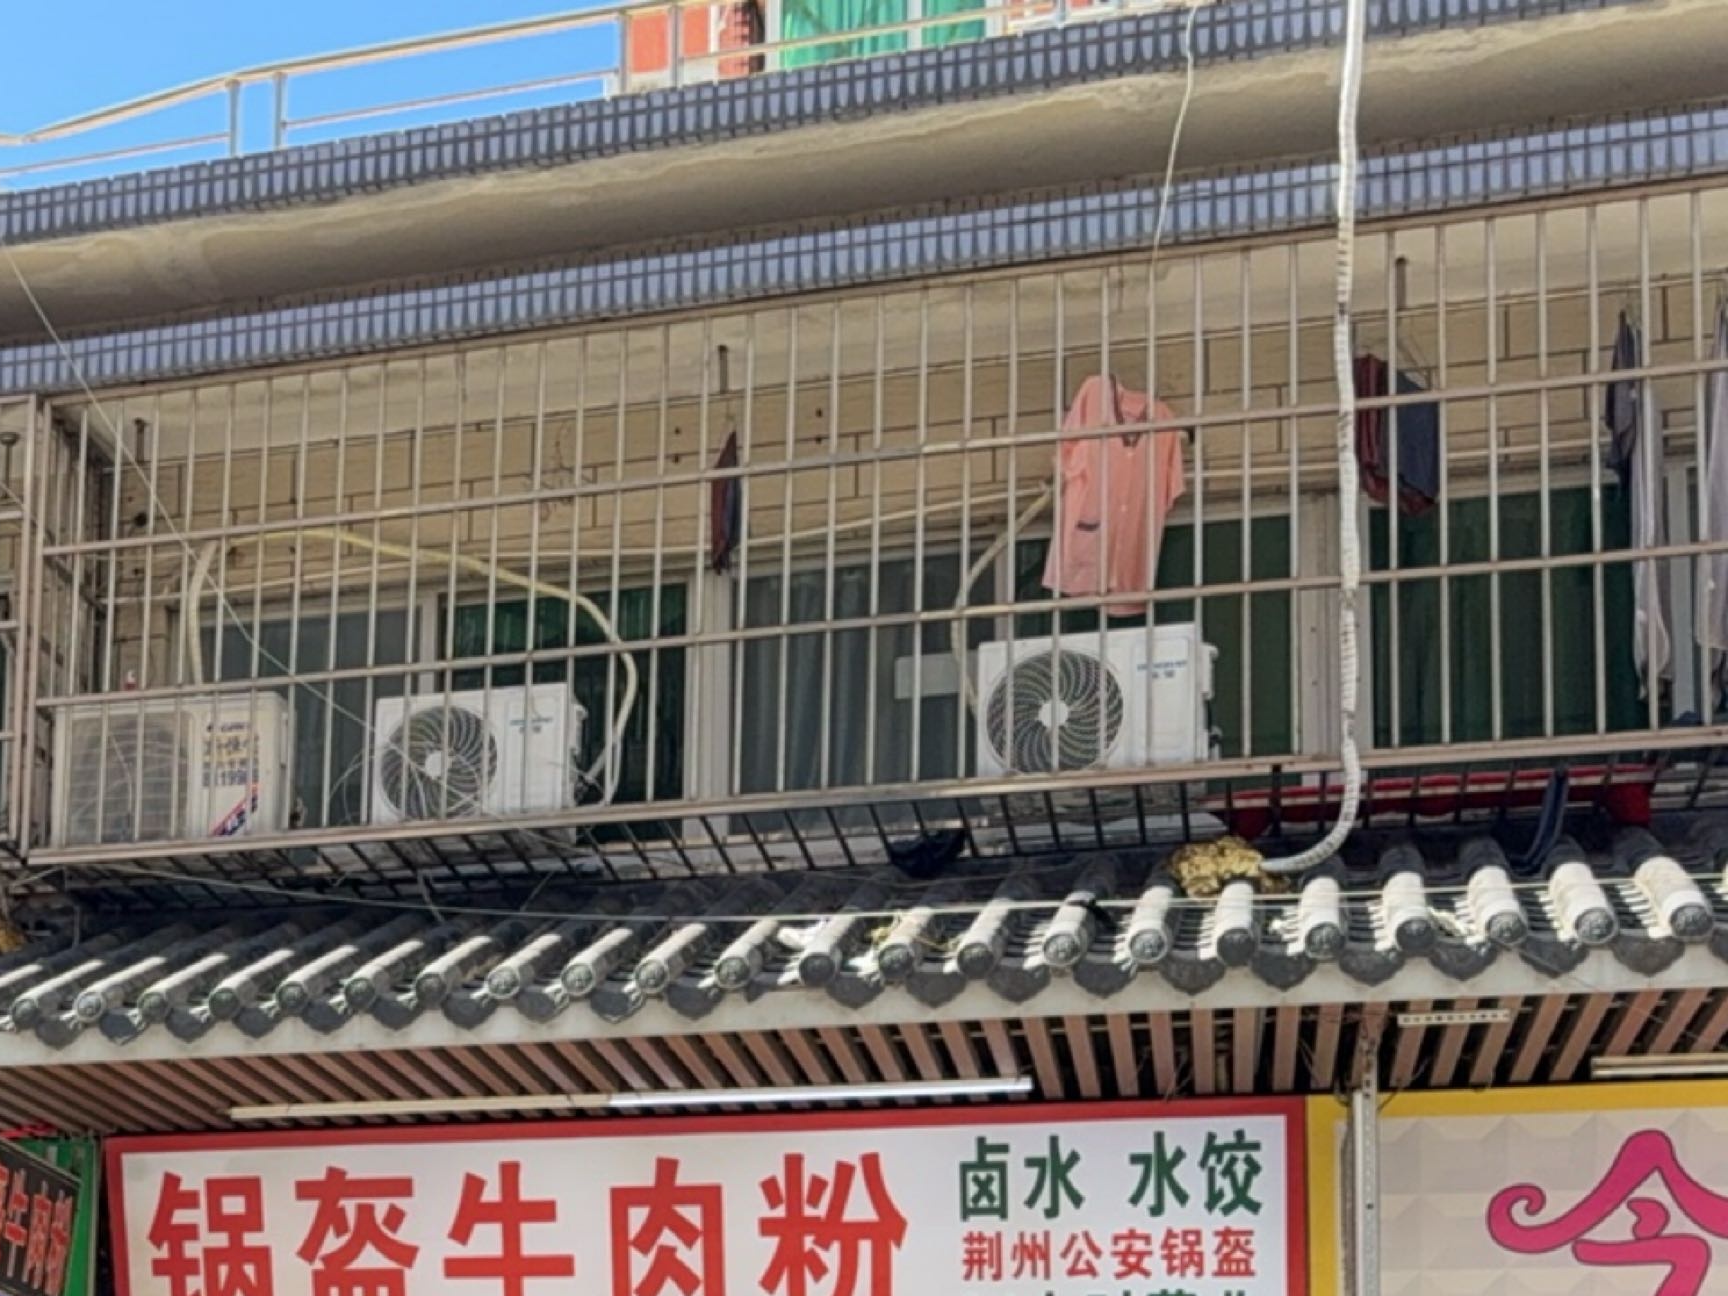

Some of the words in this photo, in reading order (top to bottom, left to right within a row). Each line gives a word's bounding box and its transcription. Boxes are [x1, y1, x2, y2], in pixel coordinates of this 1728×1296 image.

[958, 1133, 1086, 1221] 卤水
[1129, 1129, 1264, 1219] 水饺
[961, 1226, 1257, 1281] 荆州公安锅盔
